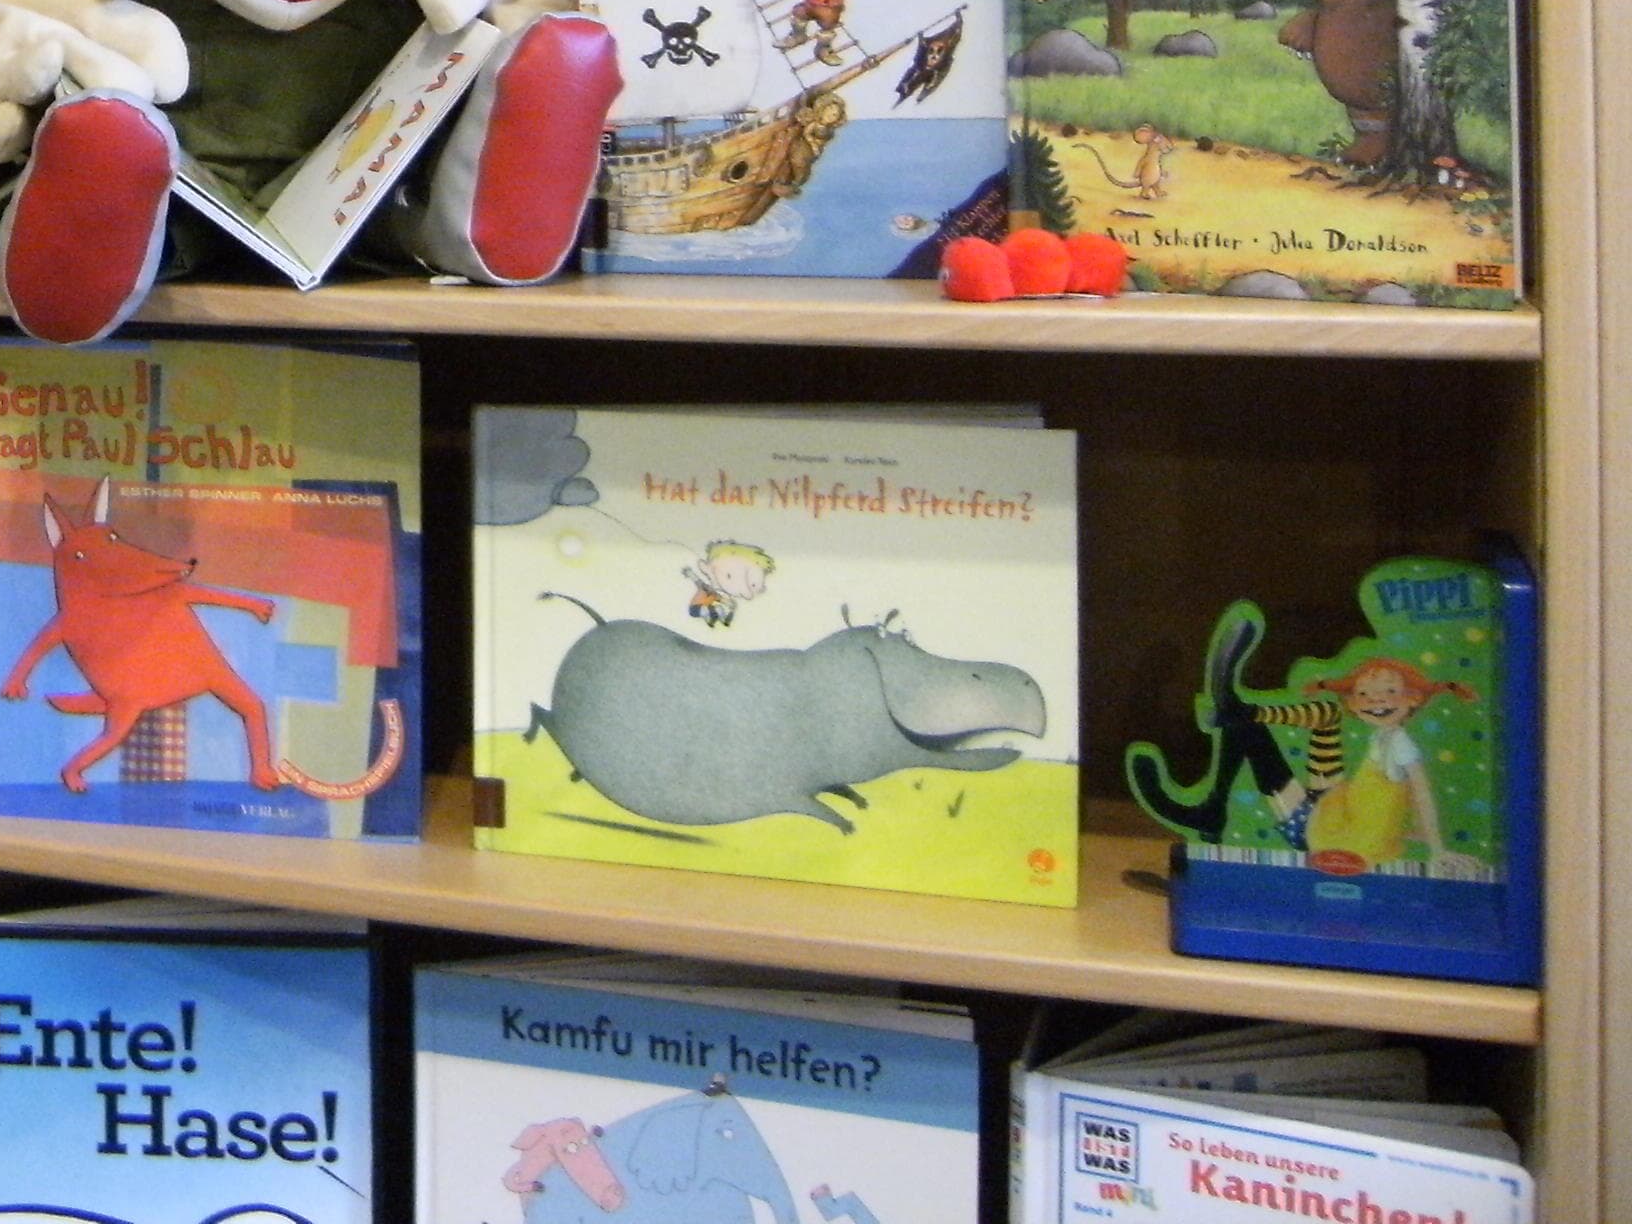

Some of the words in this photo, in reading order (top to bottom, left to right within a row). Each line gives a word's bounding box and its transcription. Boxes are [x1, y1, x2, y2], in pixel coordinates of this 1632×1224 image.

[1323, 227, 1430, 254] Donaldson
[1456, 263, 1502, 278] BELTZ
[62, 417, 137, 466] Paul
[145, 423, 296, 471] Schlau
[120, 486, 184, 499] ESTHER
[188, 488, 262, 502] SPINNER
[271, 491, 321, 505] ANNA
[644, 472, 699, 506] Hat
[709, 468, 758, 507] das
[769, 474, 886, 518] Nilpferd
[899, 485, 1034, 522] Streifen?
[500, 1005, 632, 1058] Kamfu
[649, 1025, 715, 1069] mir
[729, 1033, 883, 1093] helfen?
[96, 1083, 340, 1164] Hase!
[1083, 1121, 1131, 1144] WAS
[1083, 1153, 1131, 1175] WAS
[1168, 1132, 1194, 1152] So
[1200, 1137, 1260, 1166] leben
[1265, 1154, 1341, 1181] unsere
